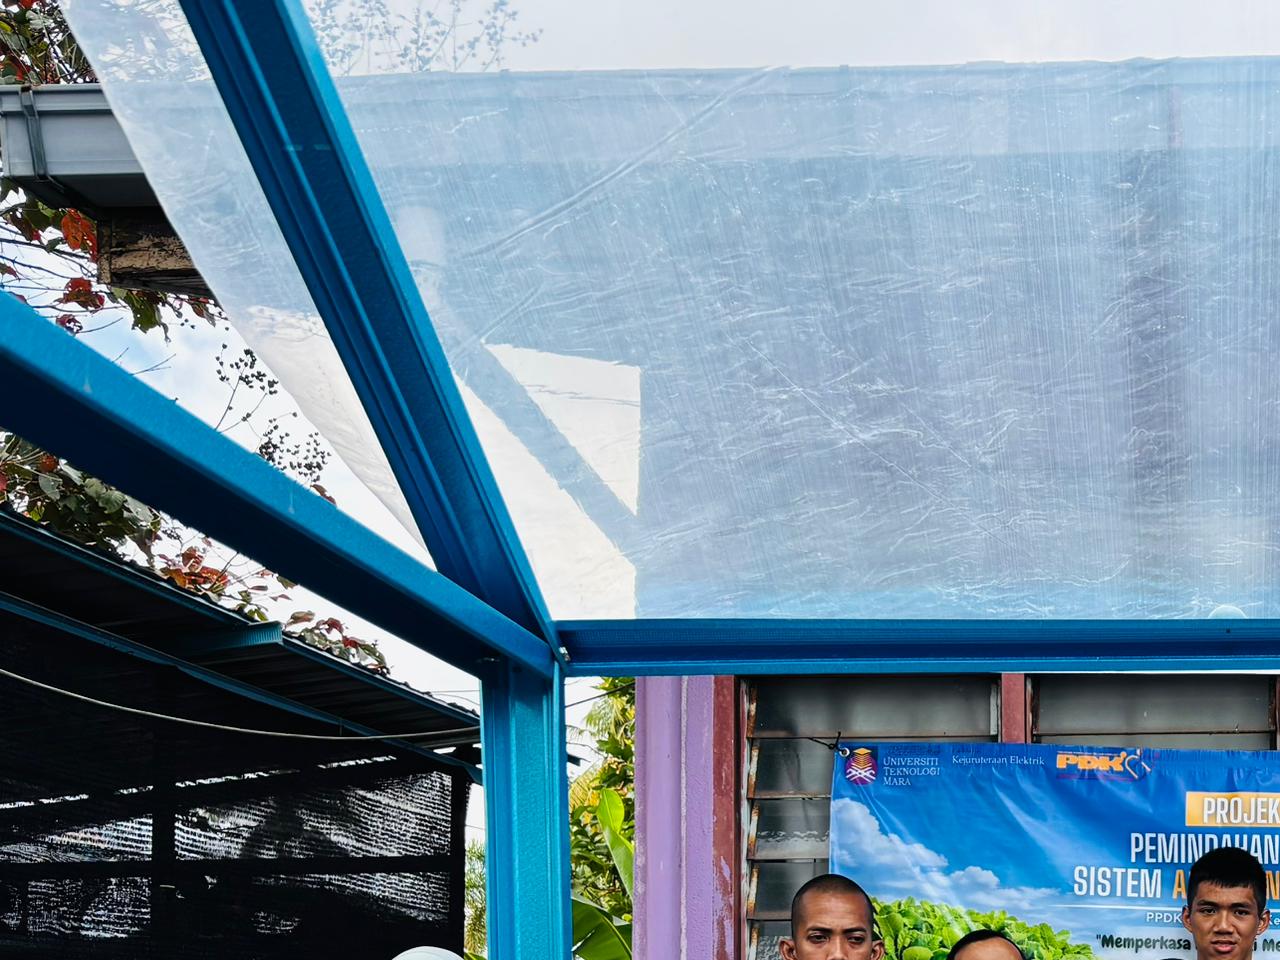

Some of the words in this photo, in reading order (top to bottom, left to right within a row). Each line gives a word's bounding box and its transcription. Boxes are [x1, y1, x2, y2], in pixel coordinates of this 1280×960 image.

[883, 756, 939, 766] UNIVERSITI
[952, 754, 1007, 767] Kejuruteraan
[1010, 755, 1045, 765] Elektrik
[1056, 754, 1124, 771] PDK
[883, 767, 940, 776] TEKNOLOGI
[883, 776, 911, 786] MARA
[1203, 797, 1280, 824] PROJEK
[1073, 865, 1162, 898] SISTEM
